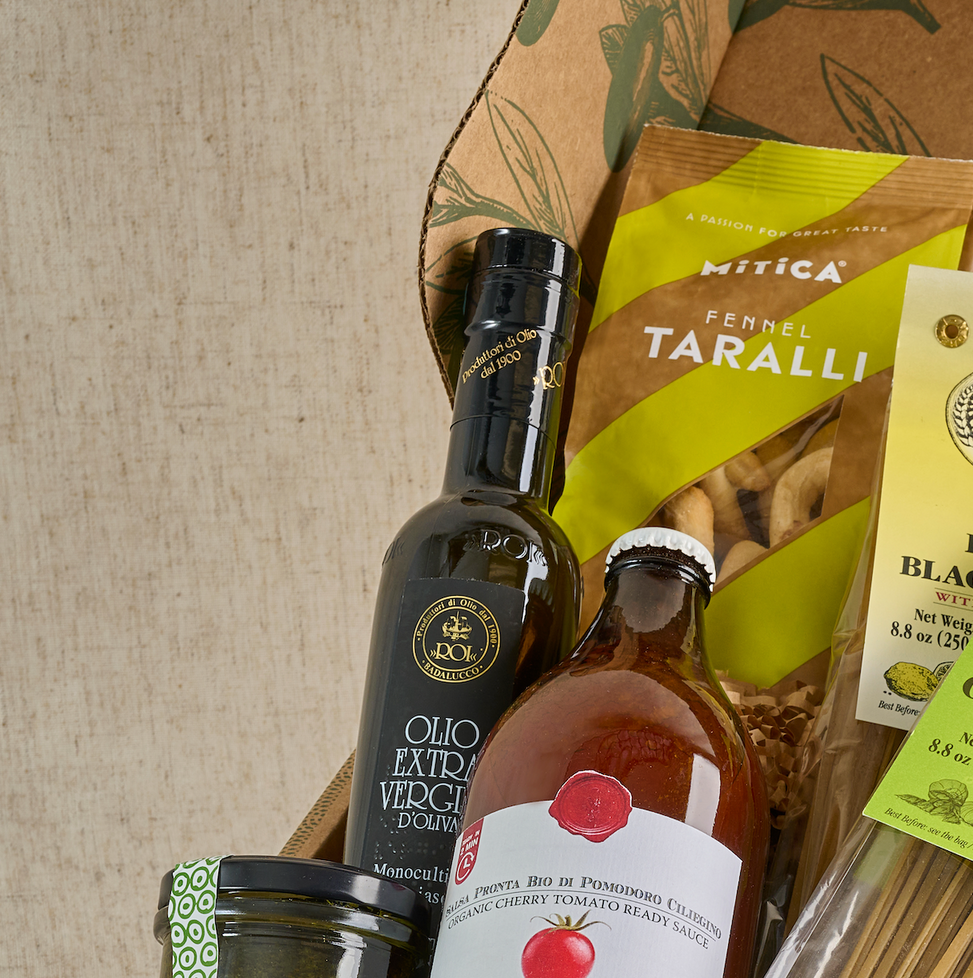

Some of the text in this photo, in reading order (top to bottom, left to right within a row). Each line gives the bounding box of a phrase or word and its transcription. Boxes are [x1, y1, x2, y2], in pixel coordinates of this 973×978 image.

[700, 214, 753, 232] PASSION
[759, 227, 787, 238] FOR
[793, 228, 839, 237] GREAT
[705, 310, 811, 338] FENNEL
[643, 326, 868, 382] TARALLI
[914, 609, 937, 623] Net
[891, 621, 933, 644] 8.8 oz
[423, 663, 480, 680] BADALUCCO
[405, 715, 480, 749] OLIO
[928, 738, 972, 766] 8.8 oz
[380, 780, 466, 814] VERGI
[398, 811, 458, 833] D'OLIVA
[374, 864, 449, 882] Monoculti
[445, 894, 470, 918] SALSA
[474, 880, 520, 899] PRONTA
[580, 876, 662, 905] POMODORO
[667, 898, 722, 940] CILIEGINO
[447, 894, 710, 950] ORGANIC CHERRY TOMATO READY SAUCE
